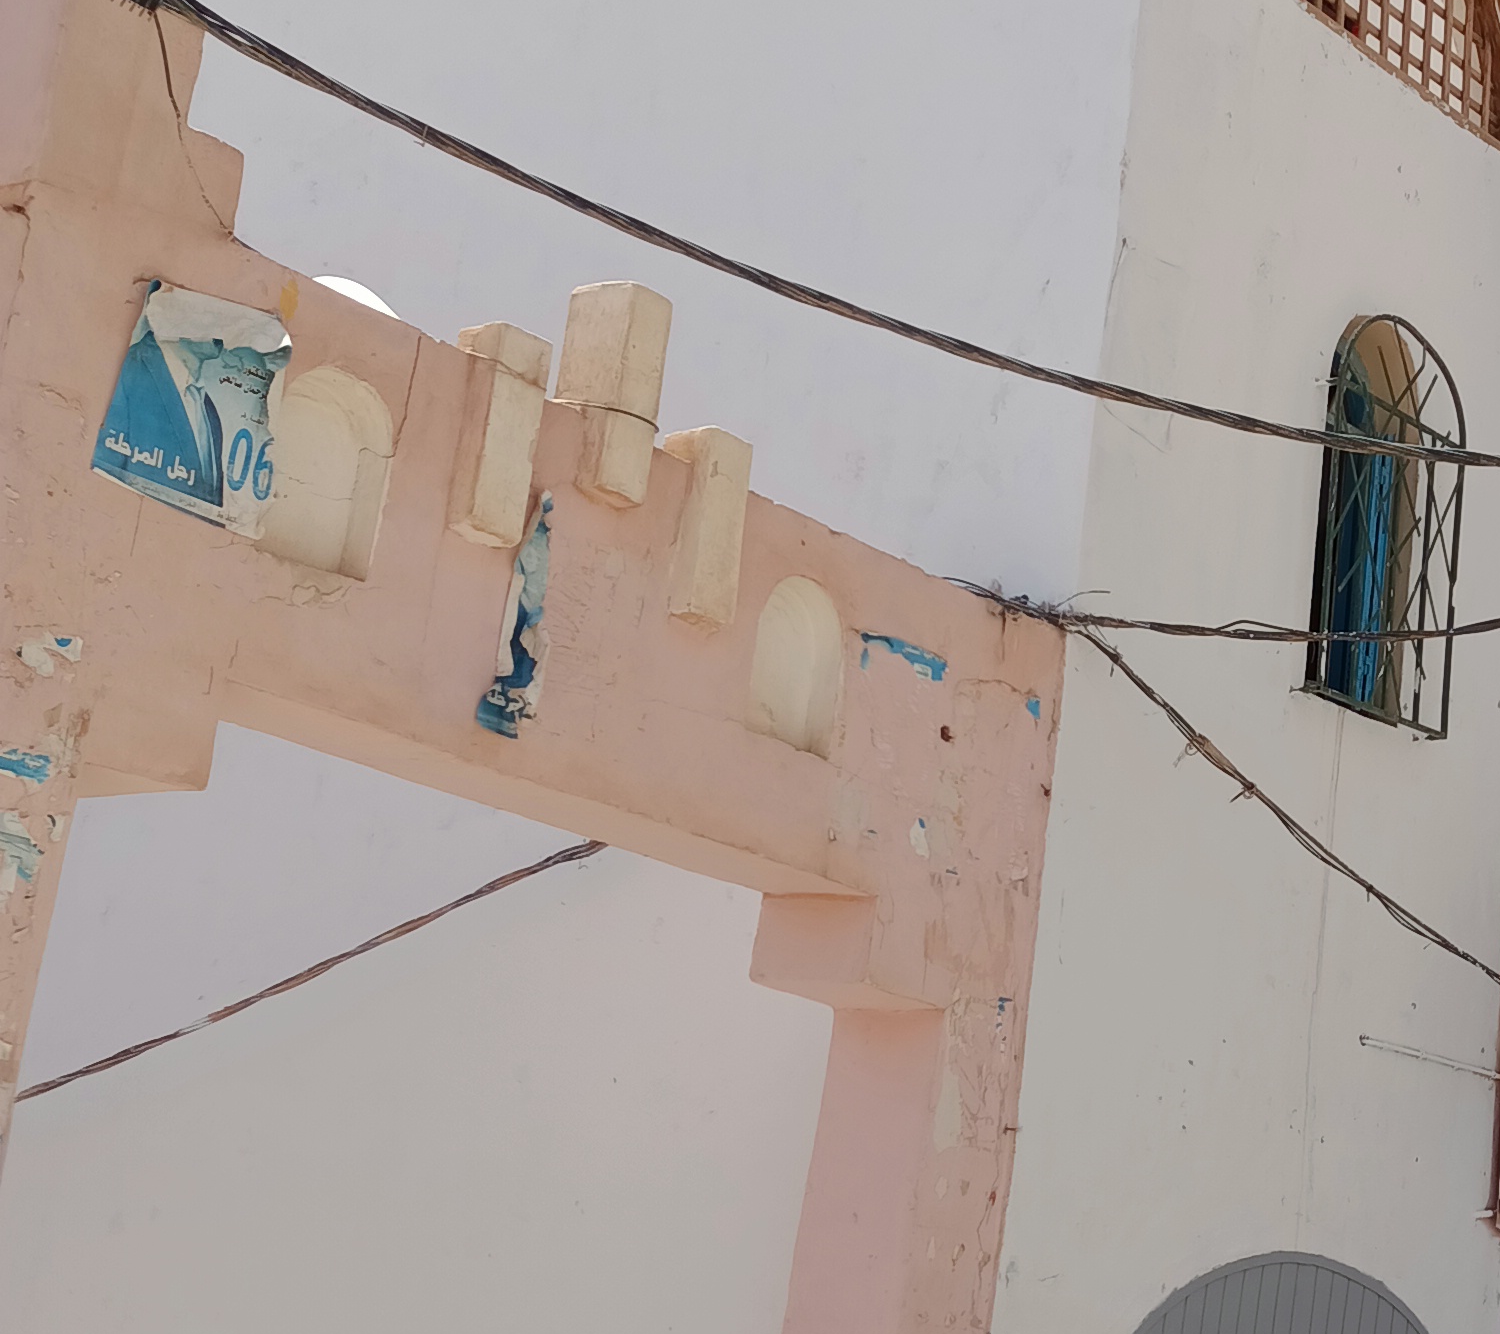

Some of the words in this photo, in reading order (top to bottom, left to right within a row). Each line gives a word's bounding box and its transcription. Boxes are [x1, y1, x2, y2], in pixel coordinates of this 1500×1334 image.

[105, 429, 164, 468] المرحلة
[227, 428, 275, 501] 06
[167, 455, 195, 486] رجل
